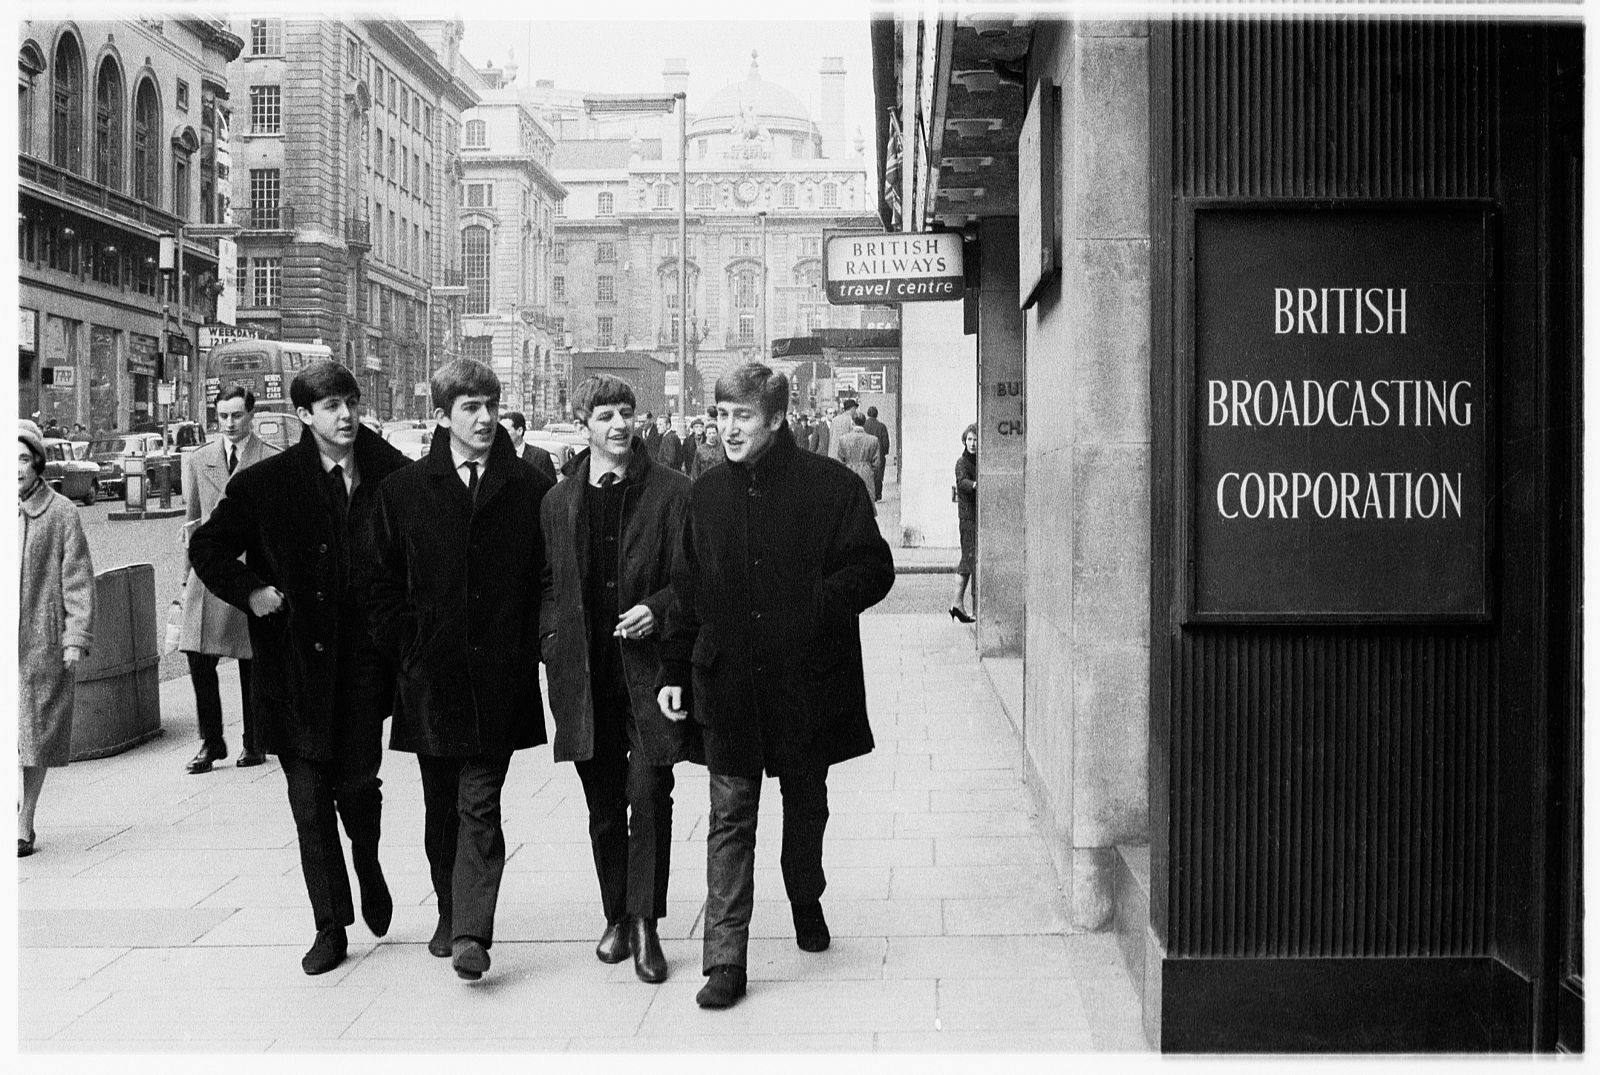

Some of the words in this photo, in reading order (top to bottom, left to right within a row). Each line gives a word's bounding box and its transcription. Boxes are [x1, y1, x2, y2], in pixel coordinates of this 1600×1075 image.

[853, 239, 938, 256] BRITISH
[846, 257, 946, 275] RAILWAYS
[840, 280, 890, 297] travel
[897, 281, 953, 295] centre
[1274, 288, 1407, 334] BRITISH
[209, 327, 257, 339] WEEKDAYS
[1208, 380, 1472, 426] BROADCASTING
[1216, 472, 1462, 519] CORPORATION
